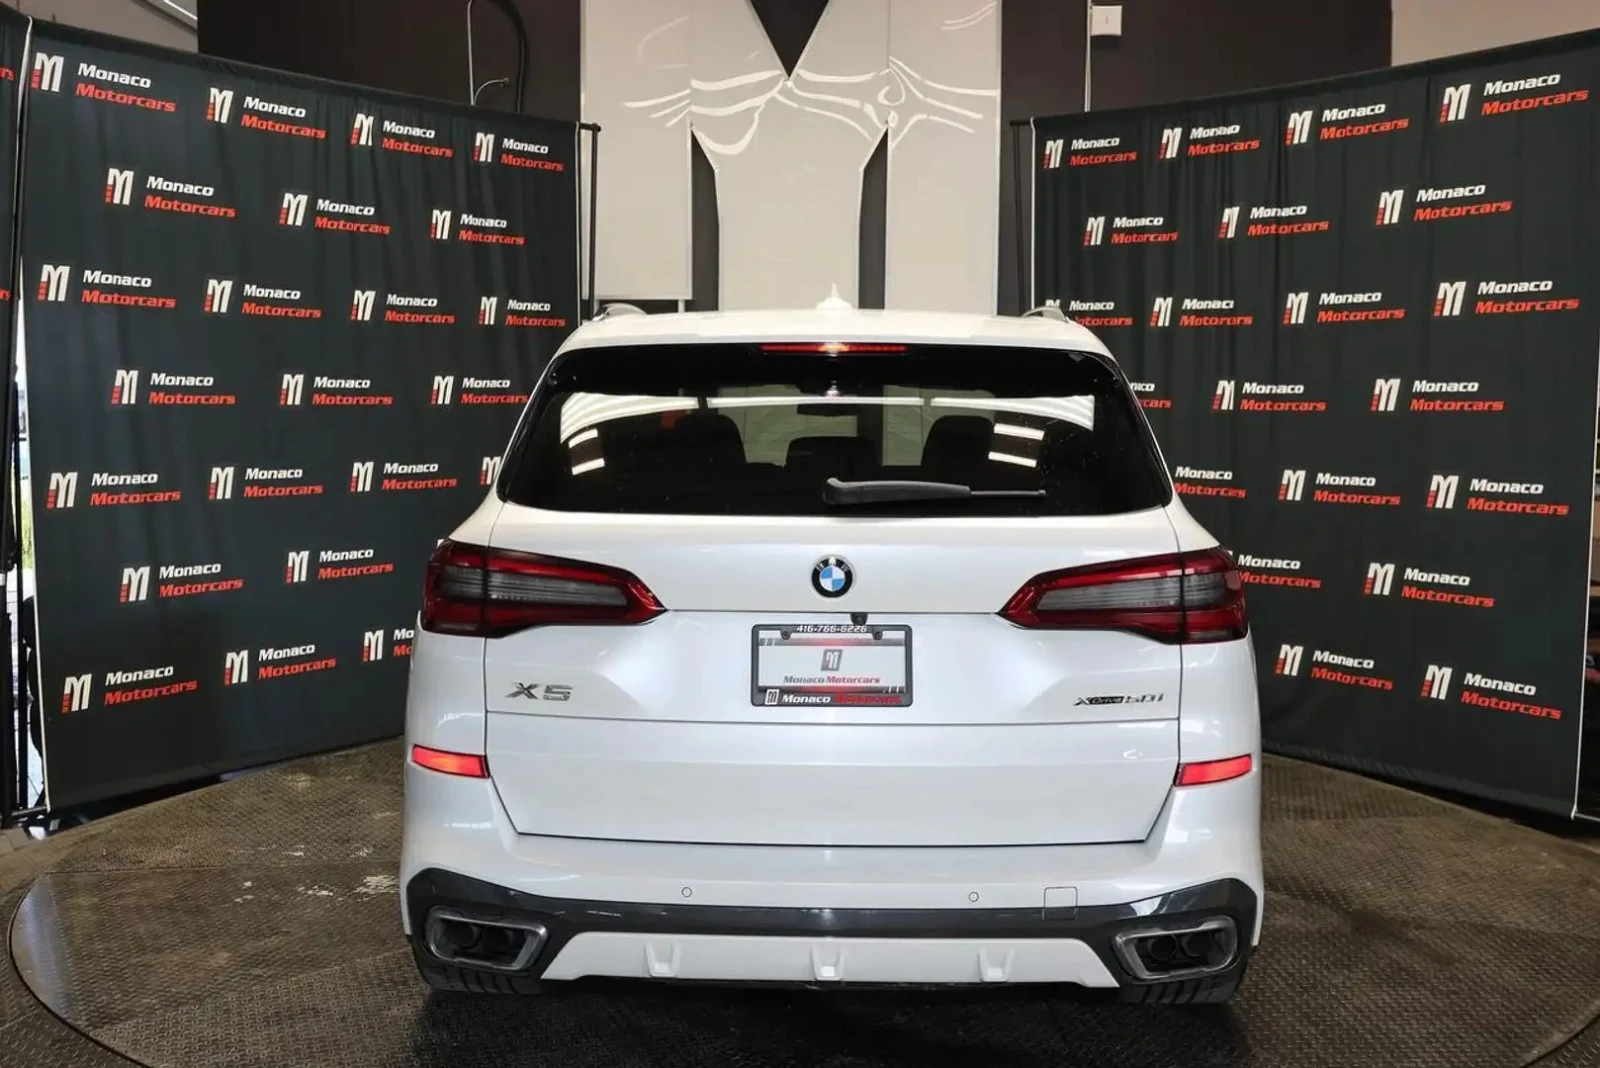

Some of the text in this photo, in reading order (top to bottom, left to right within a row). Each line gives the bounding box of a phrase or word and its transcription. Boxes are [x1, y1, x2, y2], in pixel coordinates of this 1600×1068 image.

[78, 63, 151, 88] Monaco
[1483, 74, 1560, 96] Monaco
[76, 83, 176, 112] Motorcars
[1481, 89, 1588, 115] Motorcars
[244, 96, 306, 117] Monaco
[1322, 104, 1386, 122] Monaco
[241, 115, 326, 138] Motorcars
[383, 120, 435, 138] Monaco
[1320, 119, 1408, 140] Motorcars
[382, 138, 453, 157] Motorcars
[502, 138, 549, 154] Monaco
[1071, 138, 1120, 150] Monaco
[501, 154, 564, 171] Motorcars
[1069, 152, 1137, 166] Motorcars
[146, 176, 214, 196] Monaco
[1416, 185, 1486, 202] Monaco
[144, 195, 236, 217] Motorcars
[316, 199, 375, 215] Monaco
[1250, 206, 1307, 219] Monaco
[1414, 201, 1512, 221] Motorcars
[315, 217, 390, 234] Motorcars
[460, 214, 507, 228] Monaco
[1248, 221, 1330, 236] Motorcars
[459, 230, 525, 245] Motorcars
[1111, 232, 1178, 244] Motorcars
[83, 270, 152, 287] Monaco
[244, 284, 301, 300] Monaco
[1478, 281, 1553, 295] Monaco
[82, 290, 176, 308] Motorcars
[387, 294, 437, 307] Monaco
[507, 299, 550, 311] Monaco
[1069, 300, 1114, 311] Monaco
[1319, 292, 1382, 305] Monaco
[242, 302, 321, 318] Motorcars
[1475, 299, 1580, 314] Motorcars
[384, 310, 456, 324] Motorcars
[505, 315, 565, 327] Motorcars
[1076, 317, 1133, 327] otorcars
[1317, 309, 1405, 323] Motorcars
[150, 373, 214, 386] Monaco
[313, 376, 370, 388] Monaco
[462, 378, 510, 388] Monaco
[1413, 380, 1479, 393] Monaco
[1242, 382, 1304, 394] Monaco
[149, 391, 236, 405] Motorcars
[312, 393, 393, 405] Motorcars
[1240, 399, 1326, 411] Motorcars
[1410, 398, 1504, 411] Motorcars
[245, 468, 302, 480] Monaco
[383, 463, 438, 474] Monaco
[1175, 466, 1233, 480] Monaco
[91, 473, 158, 486] Monaco
[382, 478, 457, 490] Motorcars
[1315, 473, 1376, 486] Monaco
[1470, 479, 1543, 494] Monaco
[90, 491, 181, 506] Motorcars
[244, 485, 323, 498] Motorcars
[1313, 490, 1400, 505] Motorcars
[1467, 498, 1569, 515] Motorcars
[319, 549, 373, 563] Monaco
[1238, 554, 1301, 569] Monaco
[159, 563, 221, 579] Monaco
[318, 563, 393, 579] Motorcars
[1404, 568, 1470, 586] Monaco
[159, 579, 243, 597] Motorcars
[1401, 586, 1495, 607] Motorcars
[259, 645, 315, 662] Monaco
[1313, 651, 1374, 669] Monaco
[258, 658, 336, 679] Motorcars
[105, 667, 173, 686] Monaco
[783, 675, 881, 684] Monaco Motorcars
[1311, 667, 1393, 690] Motorcars
[504, 682, 573, 701] X5
[1464, 673, 1536, 696] Monaco
[104, 681, 197, 705] Motorcars
[782, 694, 831, 703] Monaco
[1461, 692, 1561, 720] Motorcars
